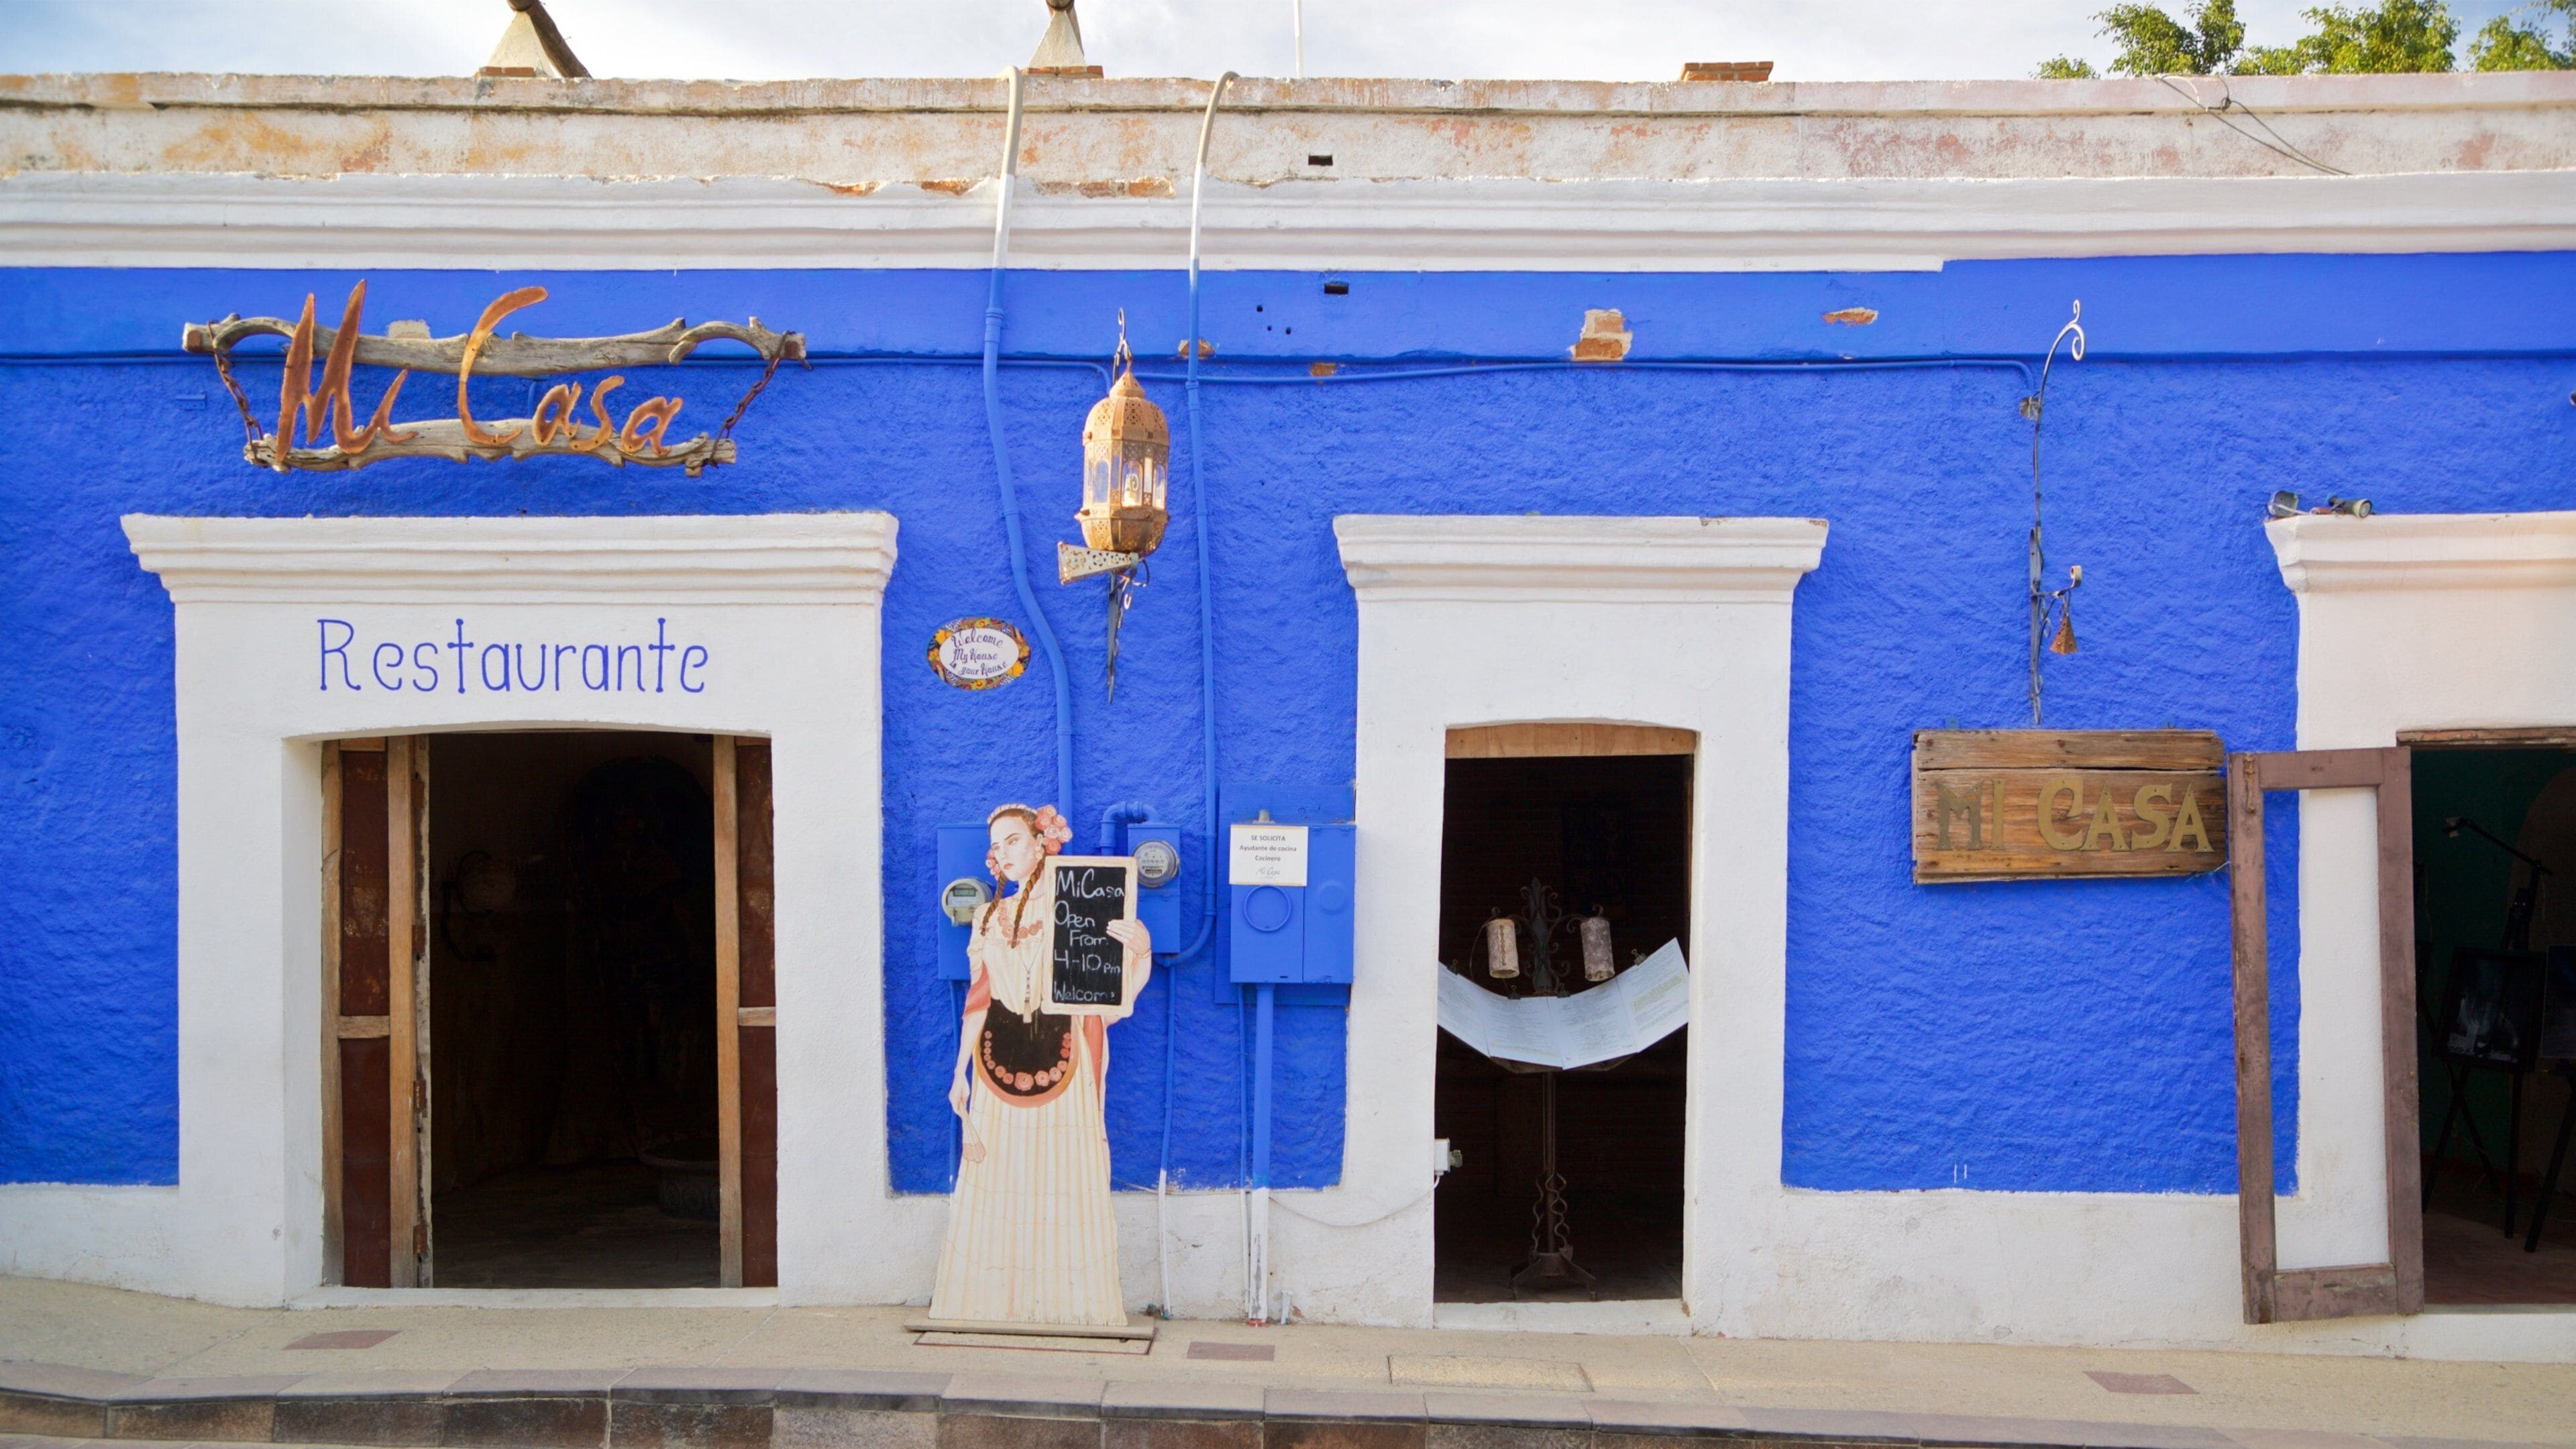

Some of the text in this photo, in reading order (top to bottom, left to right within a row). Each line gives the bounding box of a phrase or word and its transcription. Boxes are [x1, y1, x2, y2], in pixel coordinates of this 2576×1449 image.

[276, 279, 683, 463] Mi Casa
[951, 629, 1004, 648] Welcome
[317, 619, 708, 694] Restaurante
[2037, 777, 2214, 853] CASA
[1055, 900, 1095, 928] Open
[1069, 929, 1108, 947] From
[1055, 949, 1102, 972] 4-10
